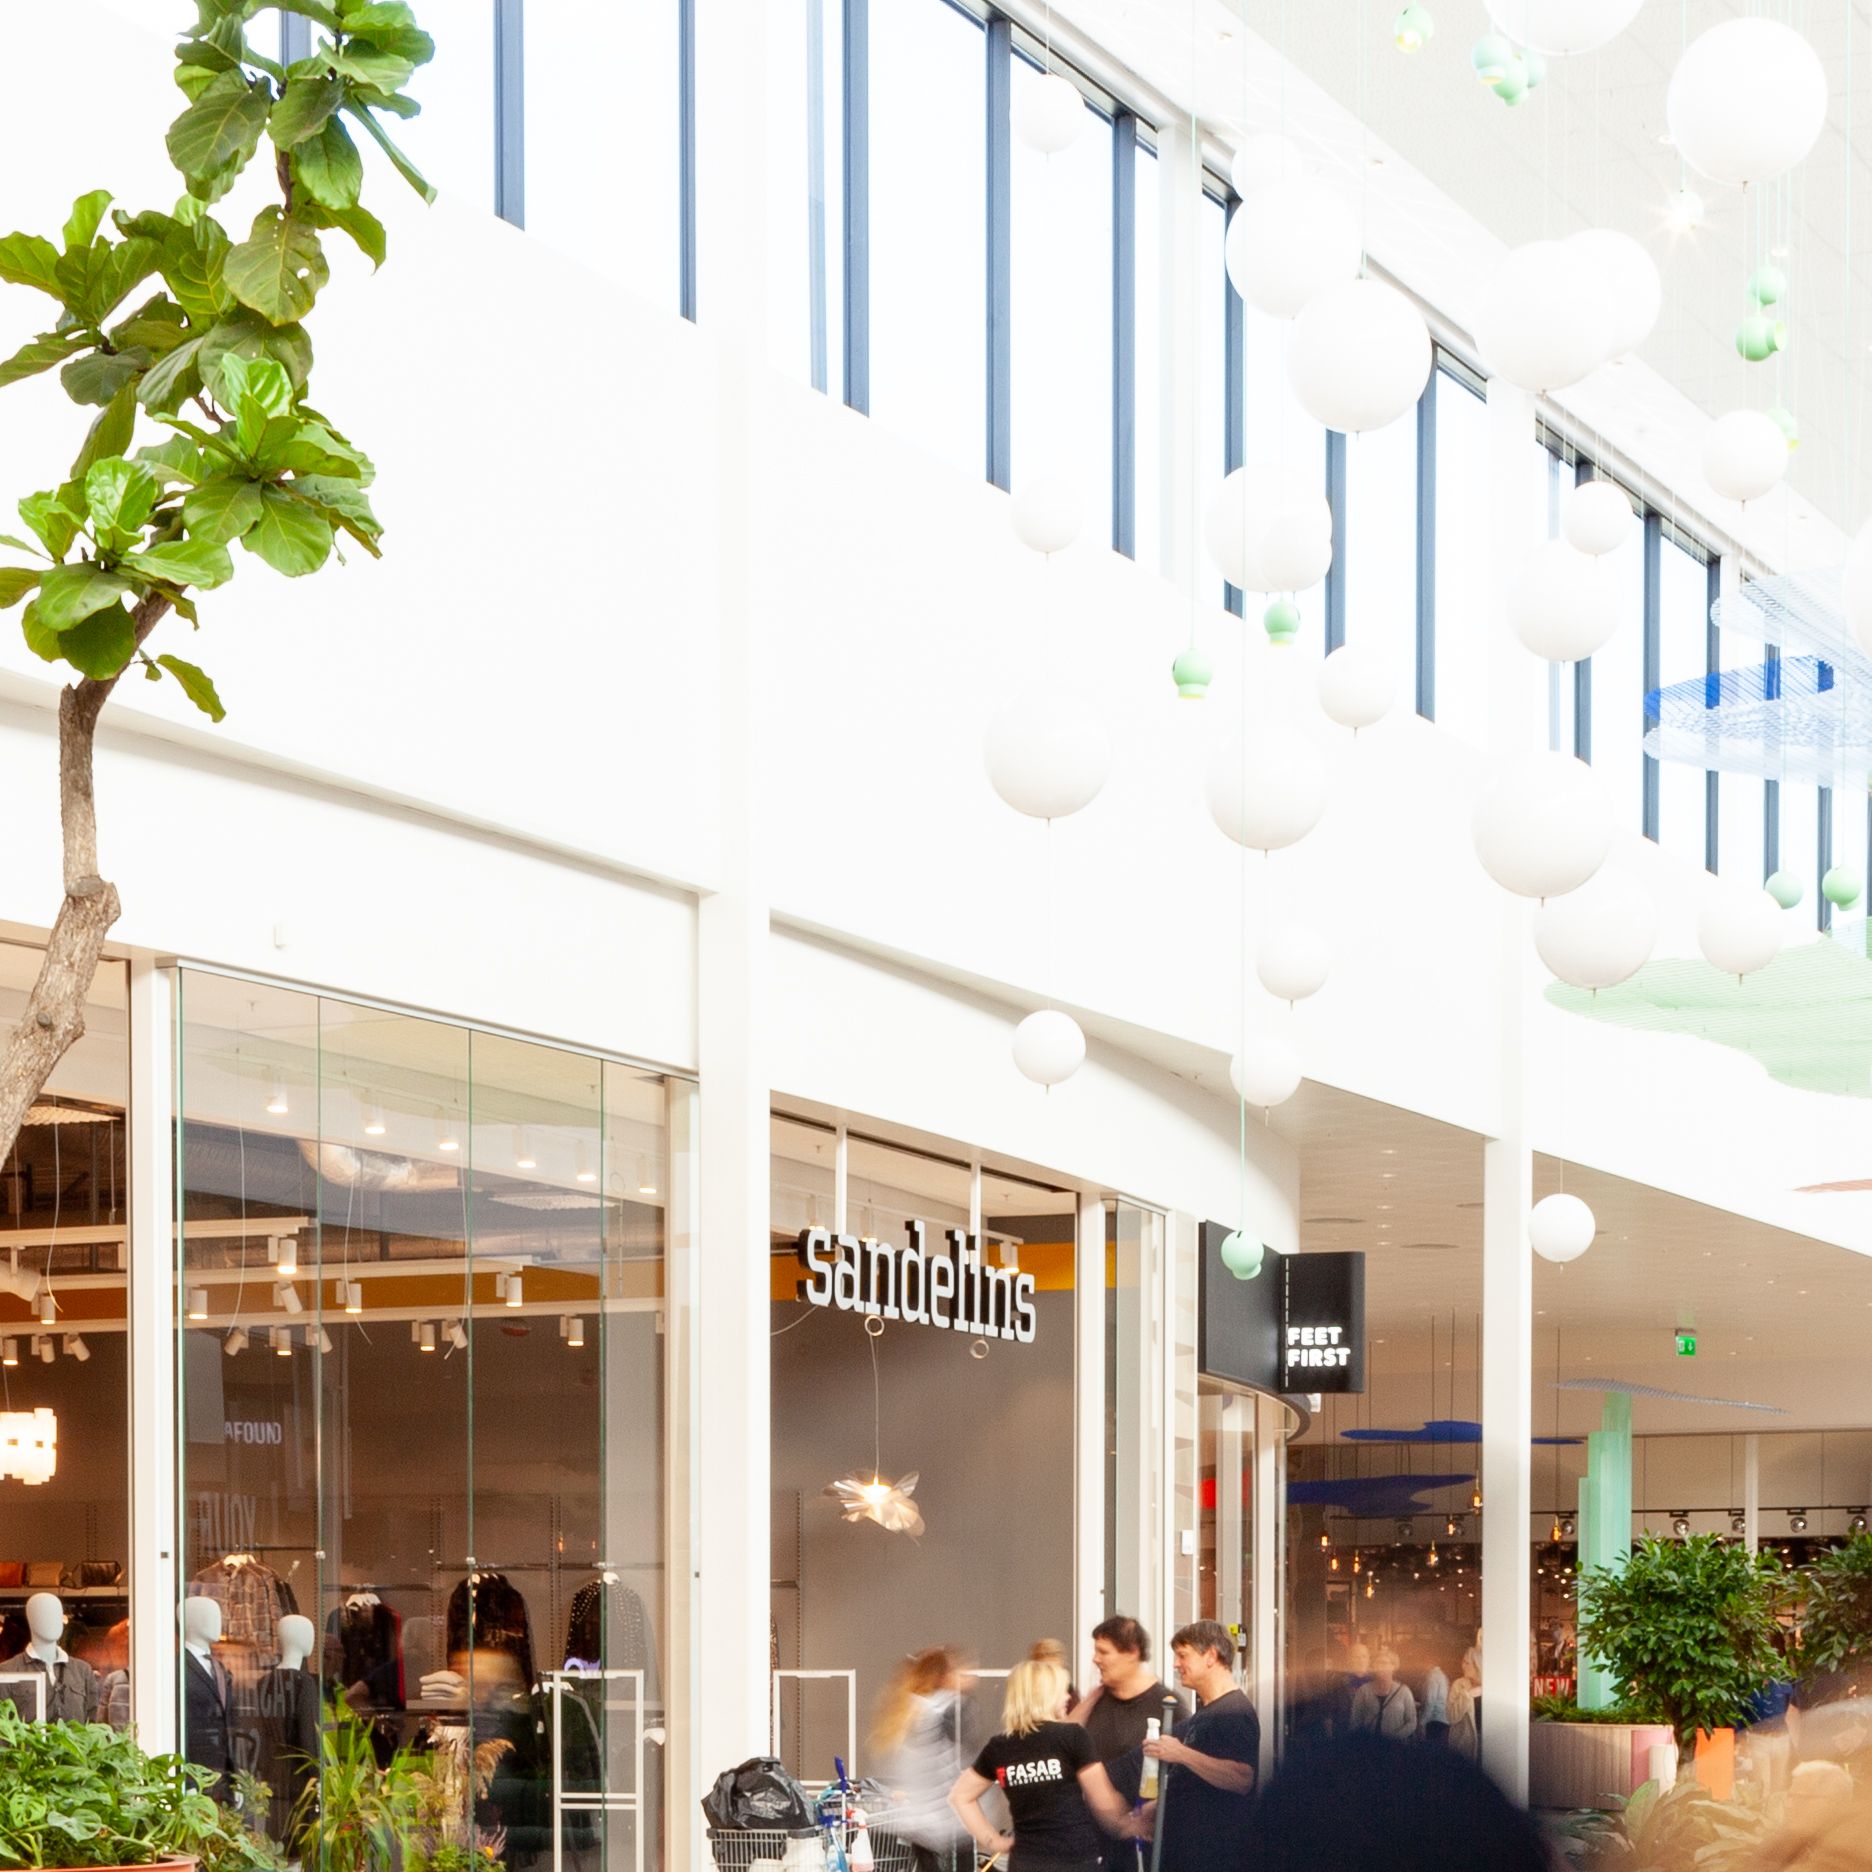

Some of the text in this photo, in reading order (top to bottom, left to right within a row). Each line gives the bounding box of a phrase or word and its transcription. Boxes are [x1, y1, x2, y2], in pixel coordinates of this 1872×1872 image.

[805, 1219, 1037, 1344] sandelins
[1287, 1326, 1343, 1346] FEET
[1287, 1347, 1351, 1368] FIRST
[1533, 1677, 1570, 1697] NEW
[1006, 1758, 1062, 1781] FASAB
